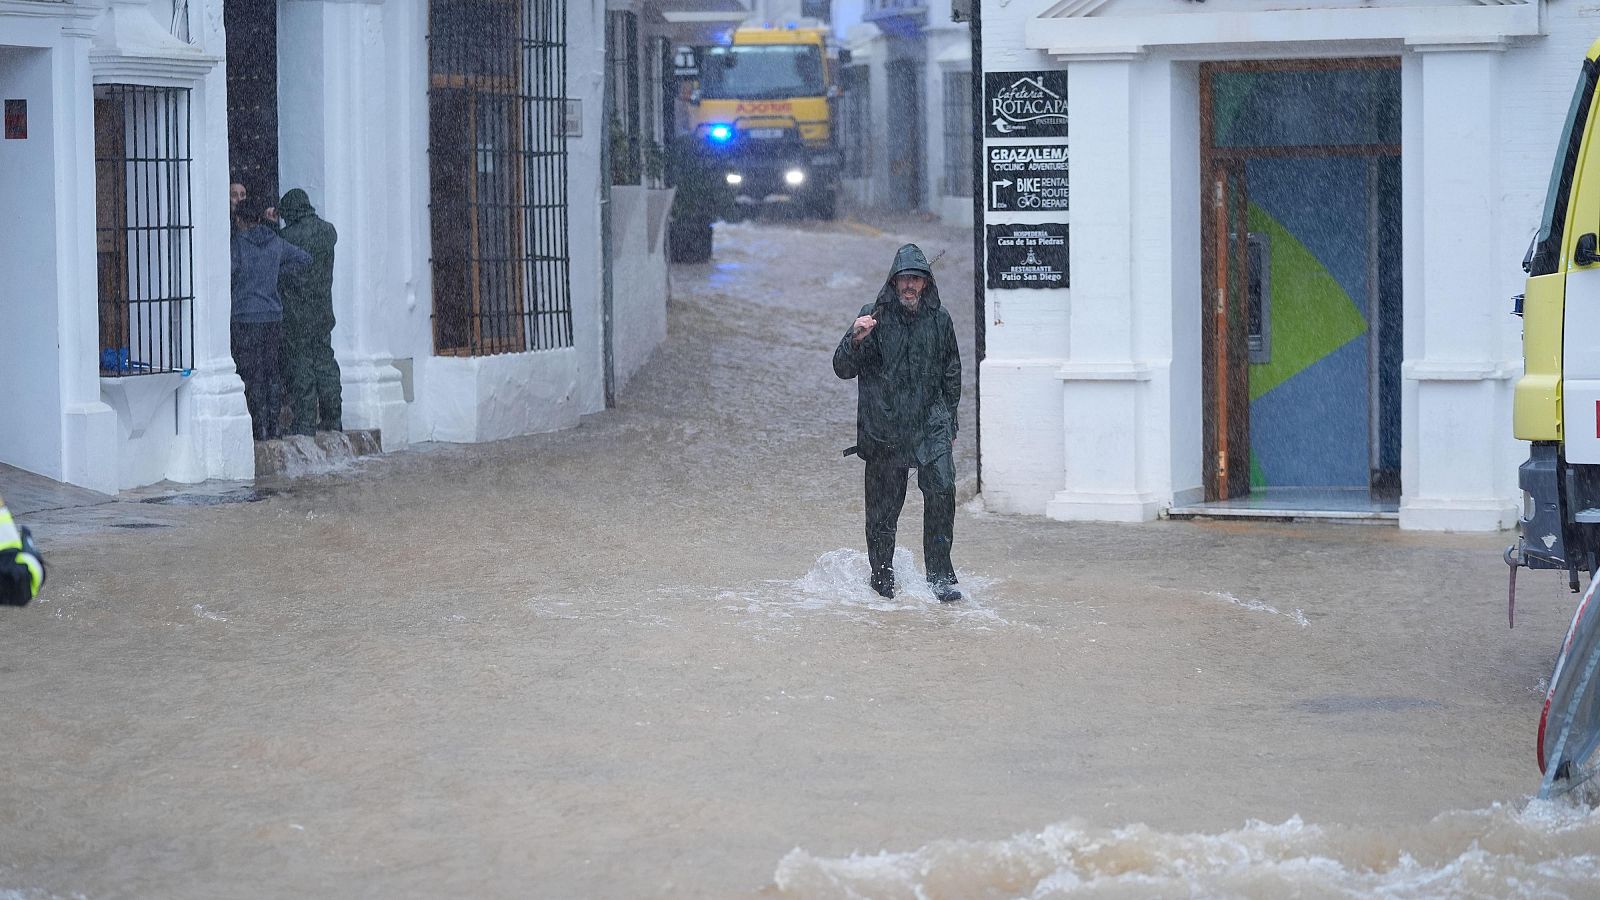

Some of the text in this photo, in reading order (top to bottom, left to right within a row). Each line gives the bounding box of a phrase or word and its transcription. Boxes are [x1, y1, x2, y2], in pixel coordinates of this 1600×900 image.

[991, 148, 1068, 160] GRAZALEMA
[994, 162, 1069, 171] CYCLING ADVENTURES
[1016, 178, 1069, 192] BIKE RENTAL
[1042, 199, 1067, 208] REPAIR
[1039, 238, 1064, 246] Piedras
[1002, 273, 1062, 282] Patio San Diego
